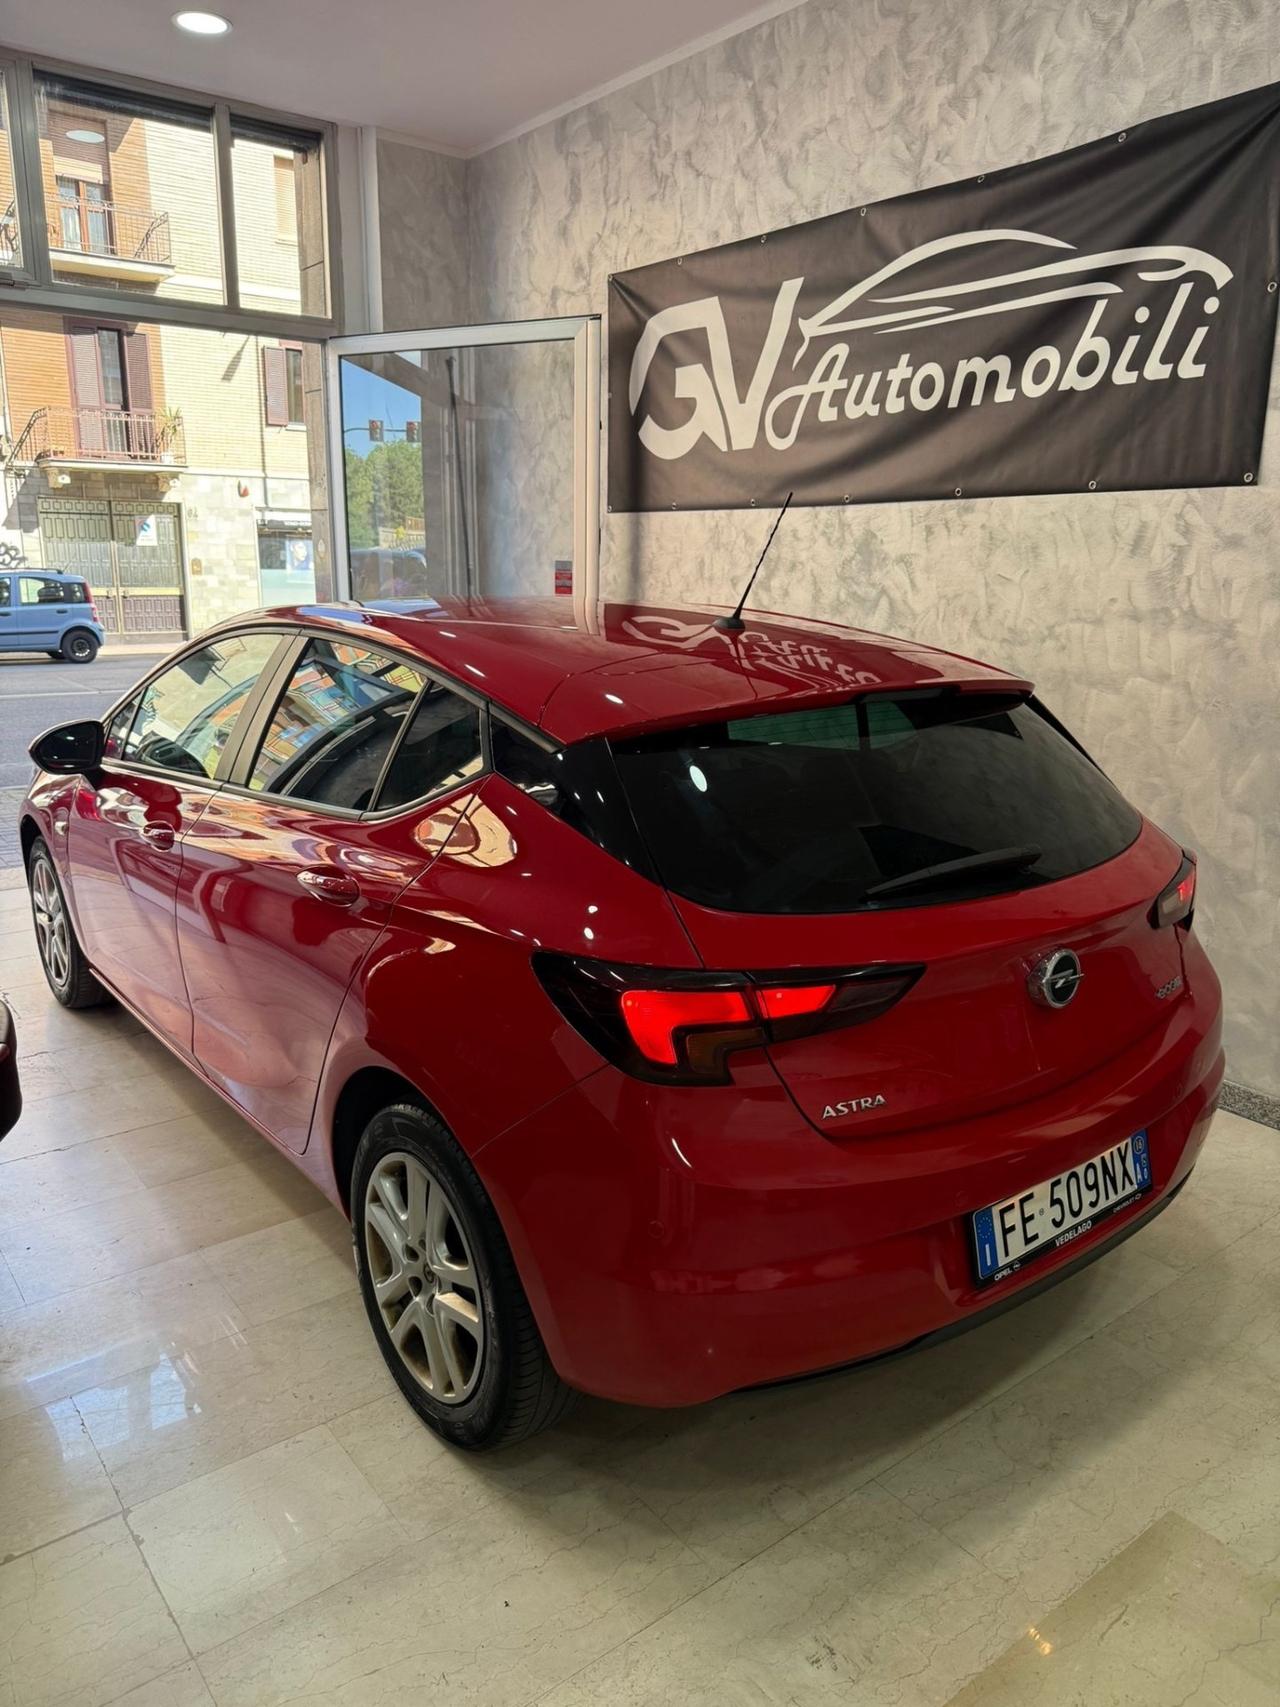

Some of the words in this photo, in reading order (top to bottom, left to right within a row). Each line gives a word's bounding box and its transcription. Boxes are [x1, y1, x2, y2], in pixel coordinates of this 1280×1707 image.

[628, 276, 805, 460] GV
[765, 281, 1221, 451] Automobili
[821, 1094, 887, 1120] ASTRA
[999, 1192, 1040, 1258] FE
[1049, 1141, 1134, 1229] 509NX
[994, 1267, 1013, 1281] OPEL
[1054, 1220, 1092, 1247] VEDELAGO
